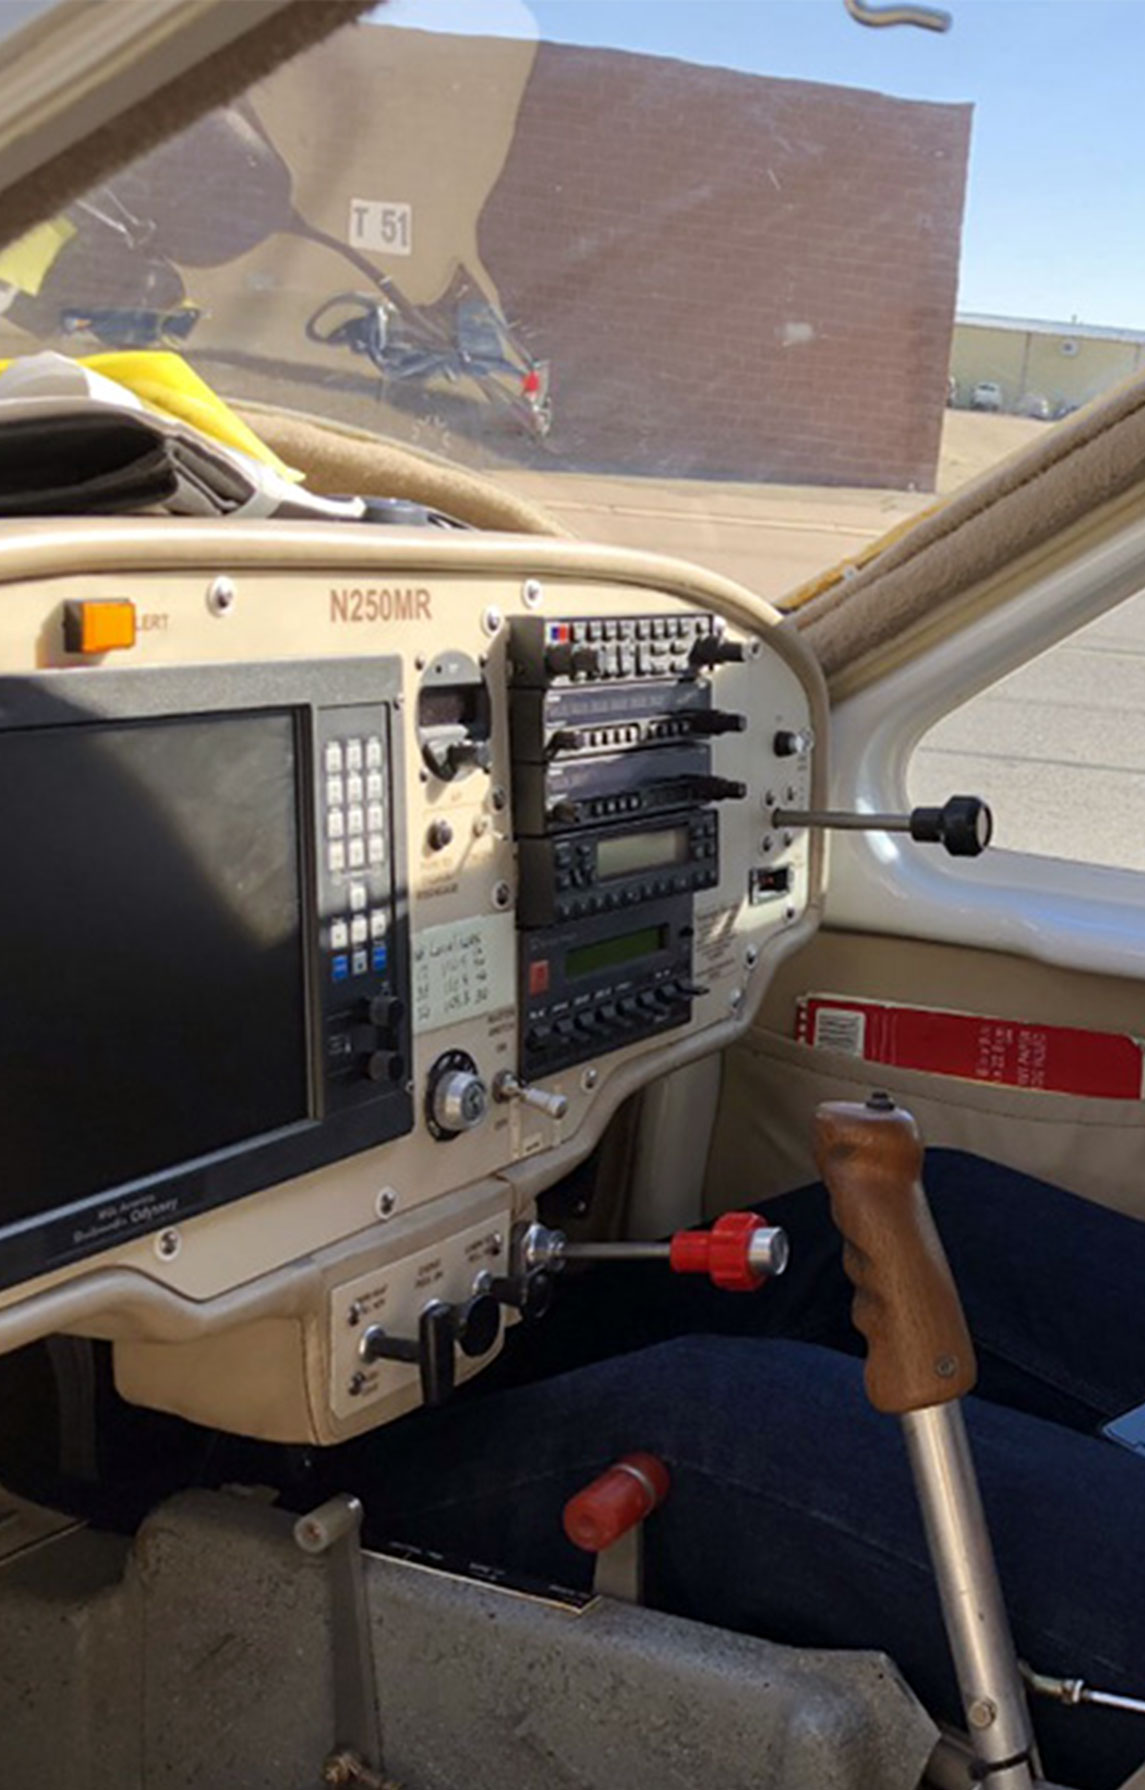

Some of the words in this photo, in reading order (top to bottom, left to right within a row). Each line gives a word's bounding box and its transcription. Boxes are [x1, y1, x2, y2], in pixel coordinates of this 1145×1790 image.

[353, 207, 369, 238] T
[381, 209, 407, 248] 51
[135, 613, 169, 631] LERT
[329, 587, 433, 622] N250MR
